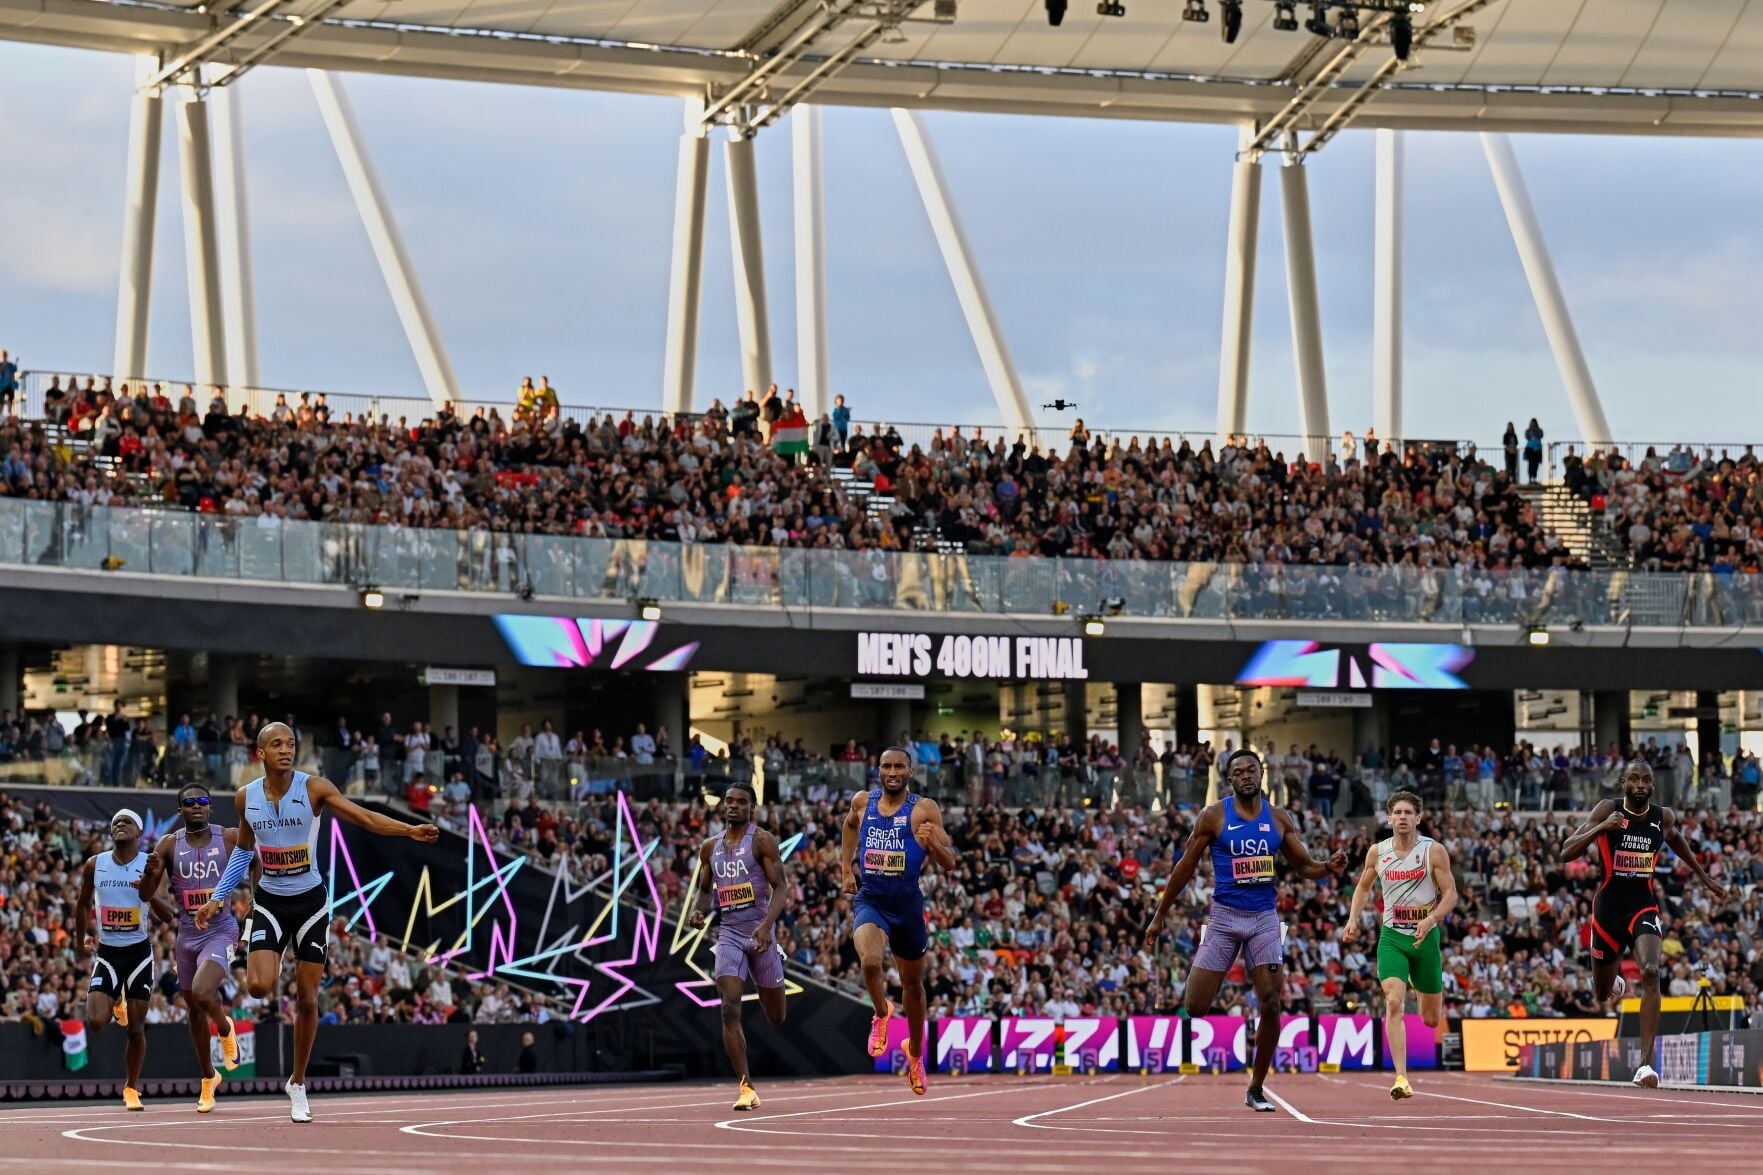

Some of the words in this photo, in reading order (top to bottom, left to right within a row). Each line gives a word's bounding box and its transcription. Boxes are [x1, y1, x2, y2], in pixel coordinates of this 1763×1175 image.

[858, 633, 931, 676] MEN'S
[937, 635, 1010, 678] 400M
[1016, 637, 1088, 679] FINAL
[253, 818, 303, 831] BOTSWANA
[868, 826, 901, 840] GREAT
[1623, 834, 1652, 845] TRINIDAD
[866, 837, 904, 850] BRITAIN
[1230, 839, 1269, 856] USA
[179, 860, 220, 879] USA
[714, 860, 749, 878] USA
[1235, 860, 1273, 875] BENJAMIN
[100, 880, 131, 888] BOTSWA
[188, 893, 212, 907] BAIL
[107, 910, 133, 923] EPPIE
[1395, 909, 1428, 920] MOLNAR
[952, 1052, 964, 1067] 8
[1020, 1053, 1032, 1067] 7
[1083, 1053, 1095, 1067] 6
[1147, 1052, 1159, 1067] 5
[1212, 1052, 1223, 1066] 4
[1278, 1052, 1291, 1067] 2
